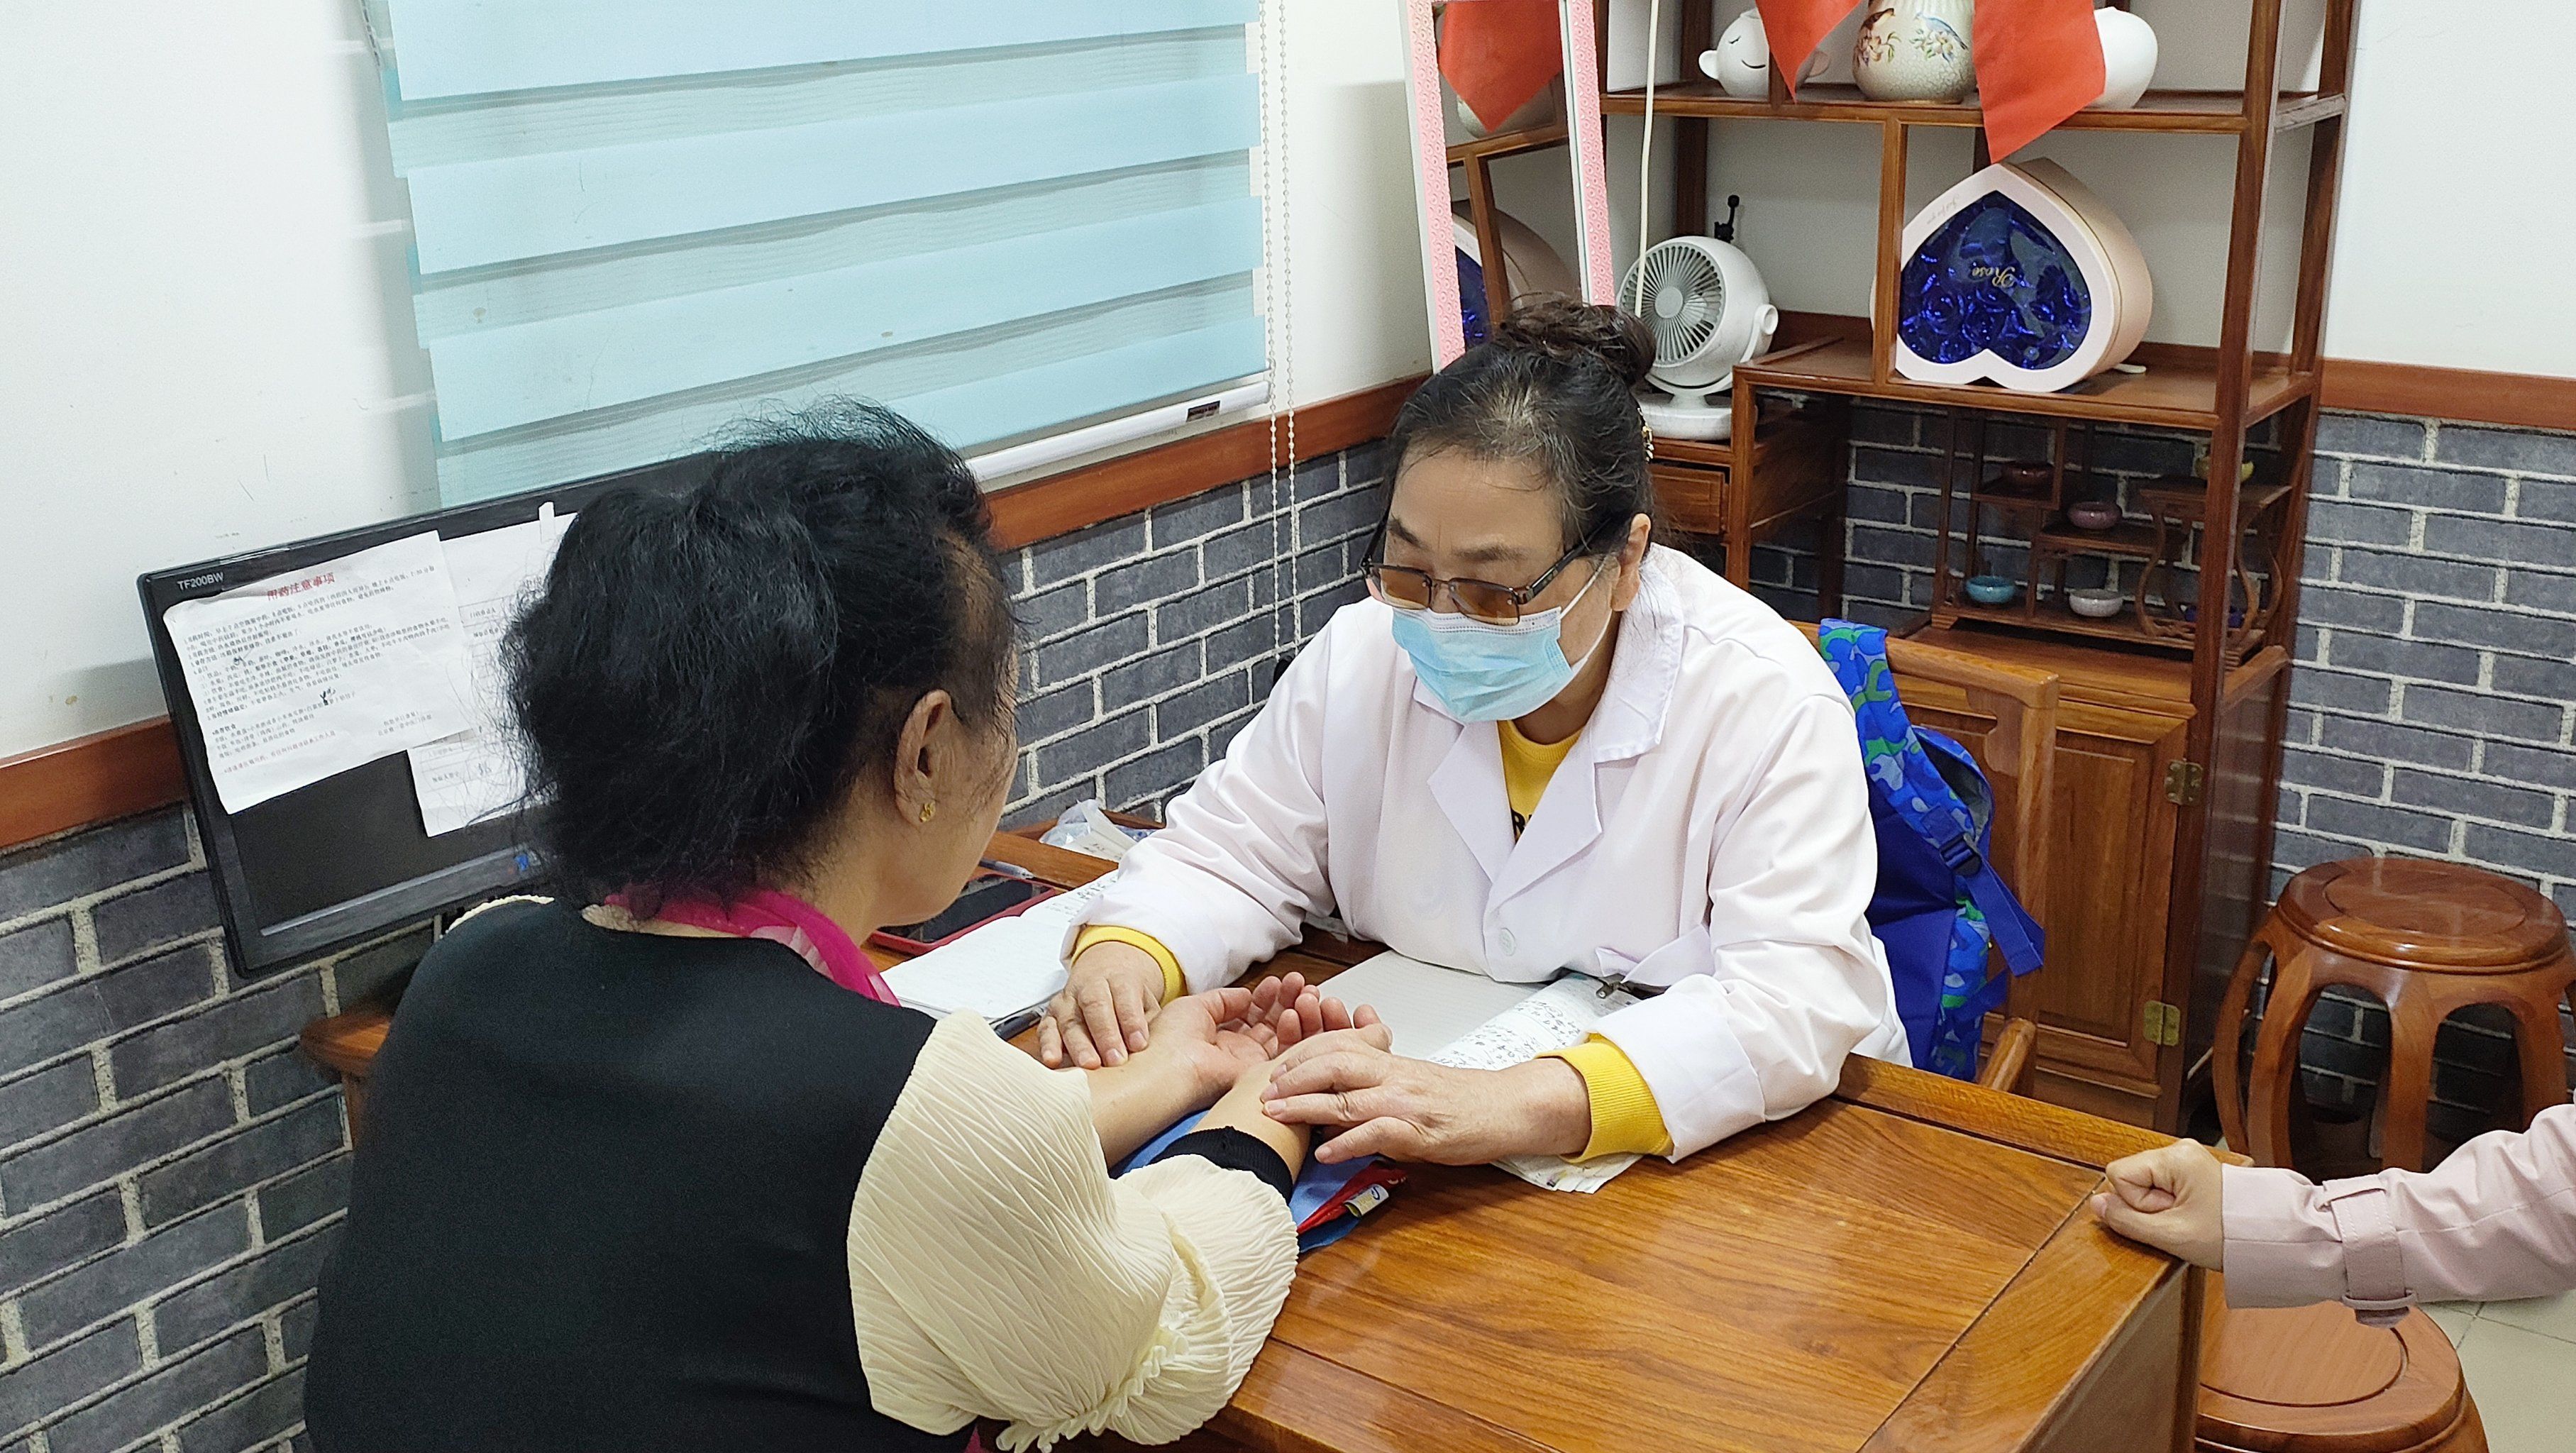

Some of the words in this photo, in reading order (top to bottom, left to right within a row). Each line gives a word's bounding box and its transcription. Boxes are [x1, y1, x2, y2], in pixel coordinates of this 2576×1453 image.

[1972, 266, 2016, 288] Rose
[177, 572, 224, 591] TF200BW
[267, 572, 336, 601] 用药注意事项
